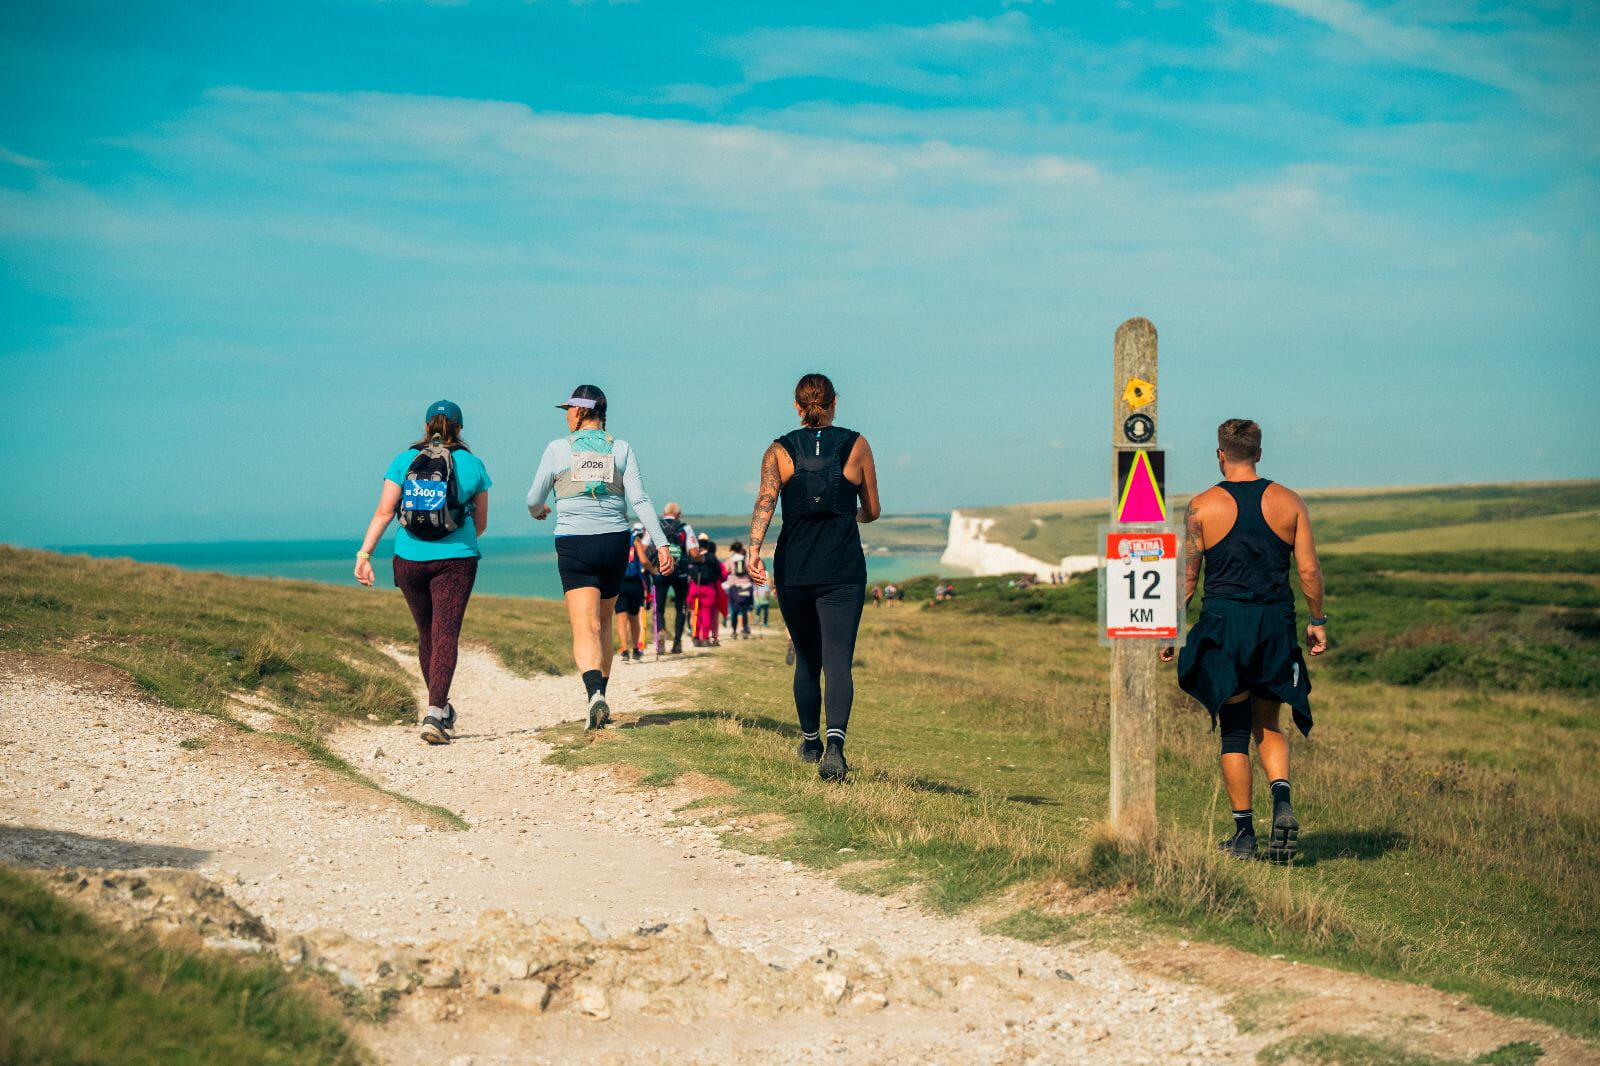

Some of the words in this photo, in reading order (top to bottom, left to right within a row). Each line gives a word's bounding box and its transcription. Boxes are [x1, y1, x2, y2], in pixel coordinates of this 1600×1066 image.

[581, 460, 604, 469] 2026
[412, 488, 436, 497] 3400
[1123, 570, 1161, 600] 12
[1130, 608, 1153, 622] KM
